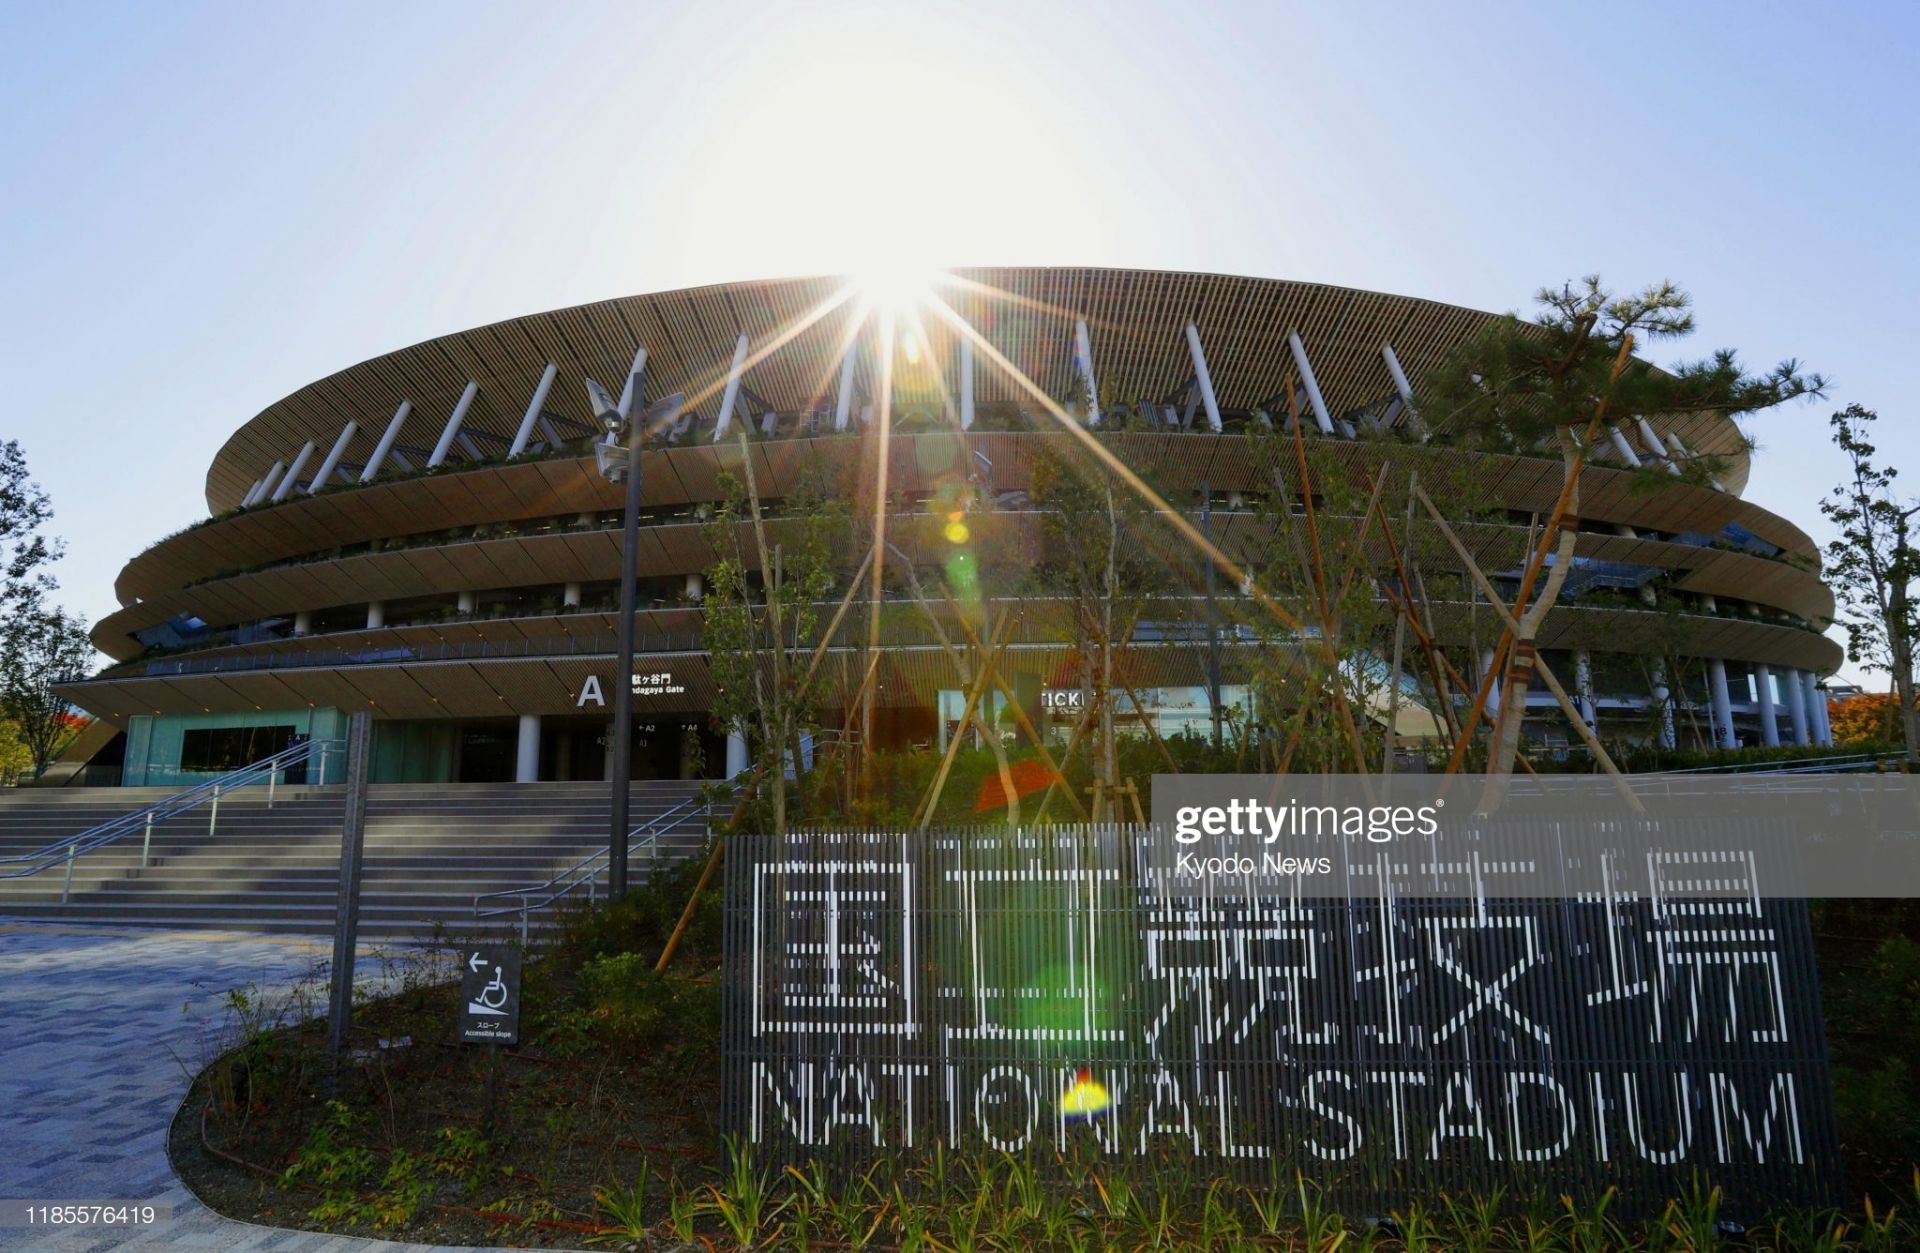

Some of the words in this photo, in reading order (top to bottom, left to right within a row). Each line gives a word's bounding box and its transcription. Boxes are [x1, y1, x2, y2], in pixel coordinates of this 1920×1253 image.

[631, 673, 671, 685] 駄ヶ谷門
[576, 675, 605, 707] A
[631, 686, 664, 695] ndagaya
[665, 685, 685, 694] Gate
[495, 1030, 512, 1038] slope
[752, 1061, 1270, 1158] NATIONAL
[1302, 1069, 1804, 1166] STADIUM
